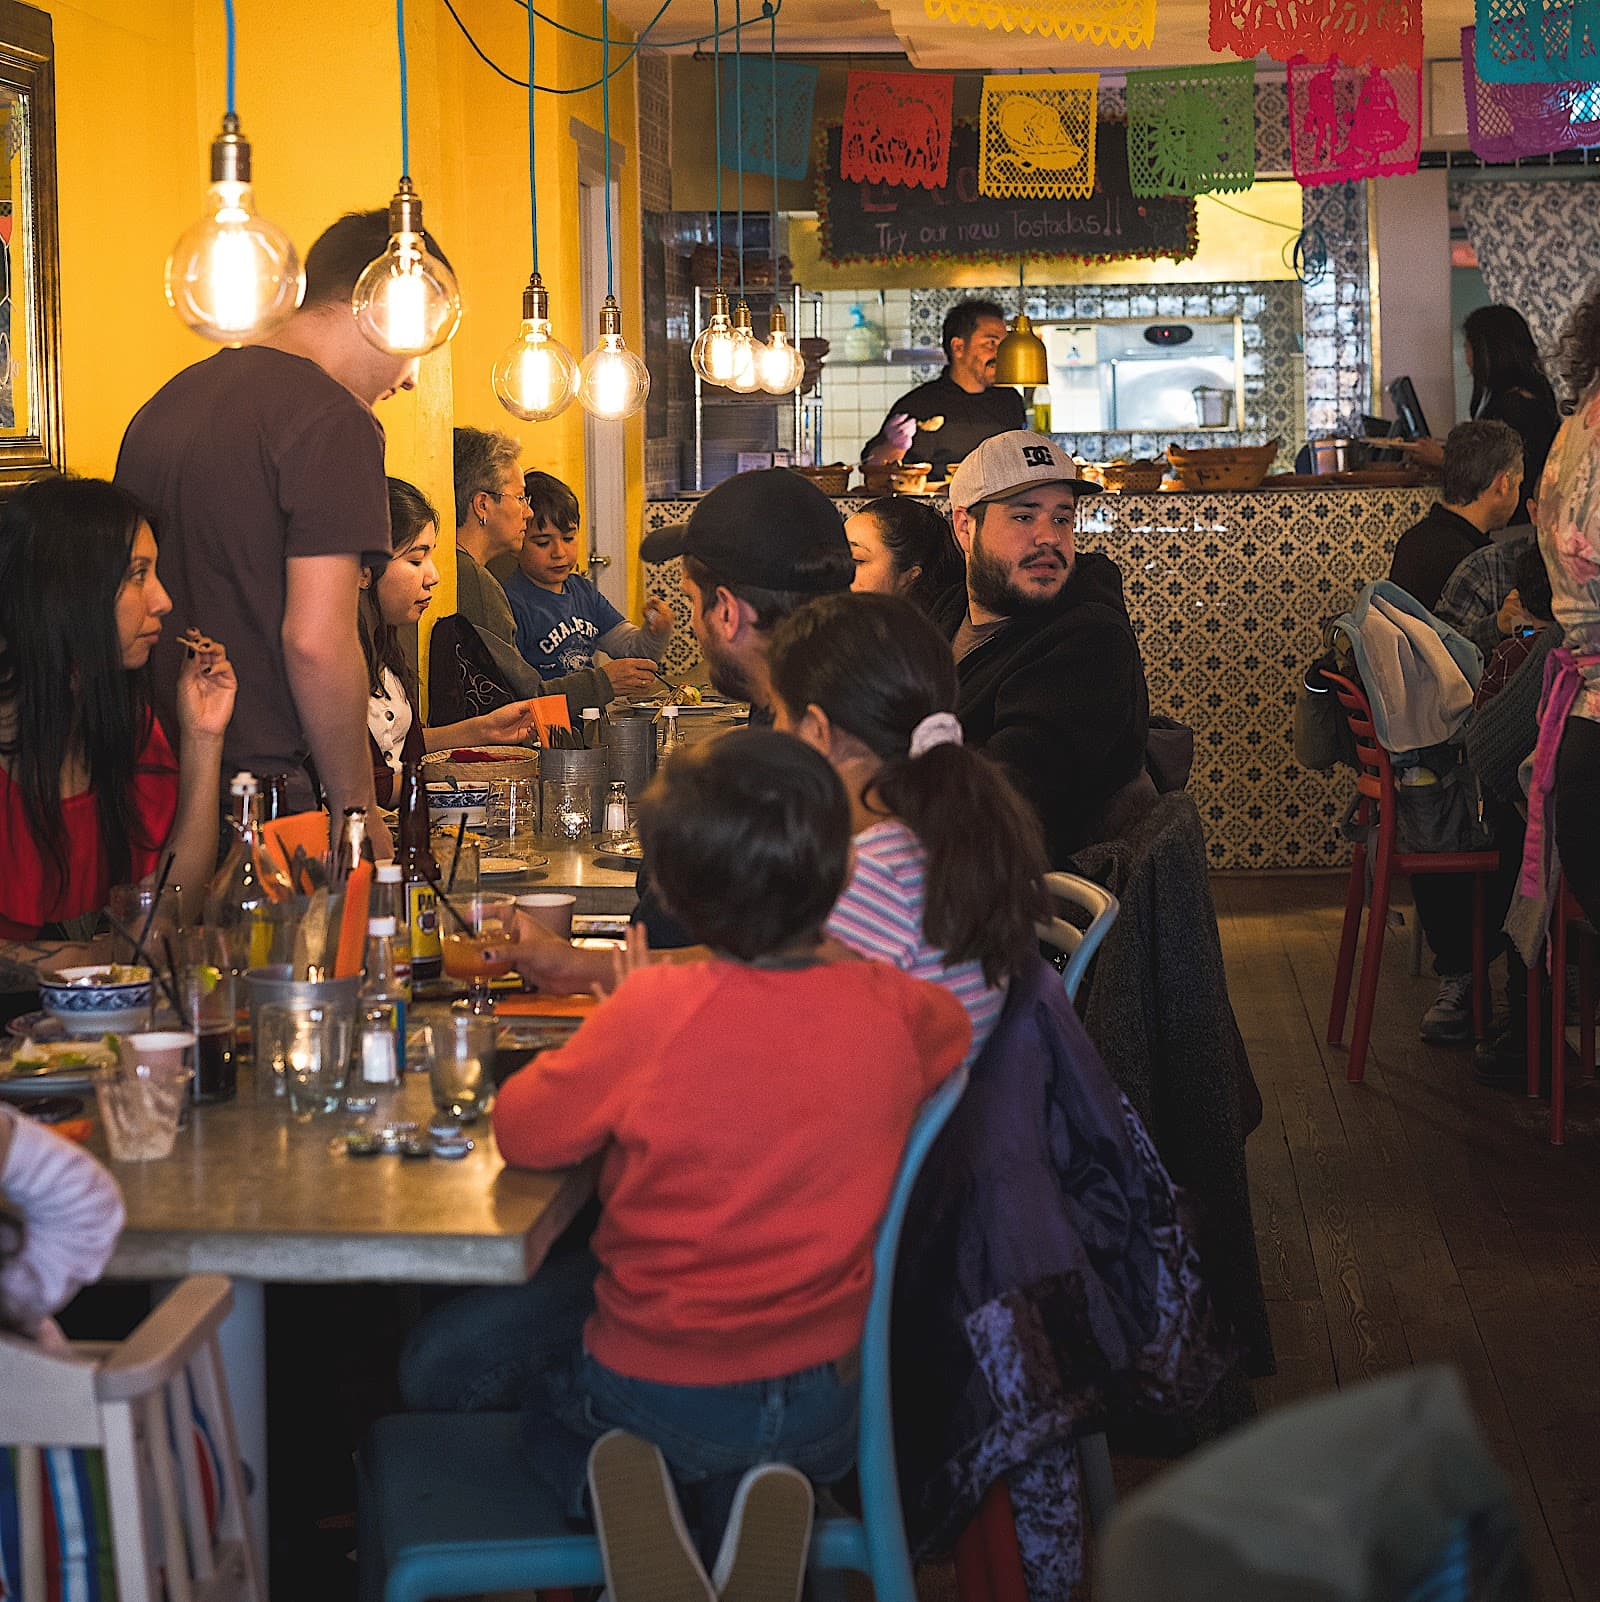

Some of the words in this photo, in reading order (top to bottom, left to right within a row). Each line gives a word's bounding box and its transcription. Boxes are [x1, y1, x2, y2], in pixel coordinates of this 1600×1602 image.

[875, 222, 907, 251] Try
[919, 226, 948, 243] our
[957, 222, 1001, 242] new
